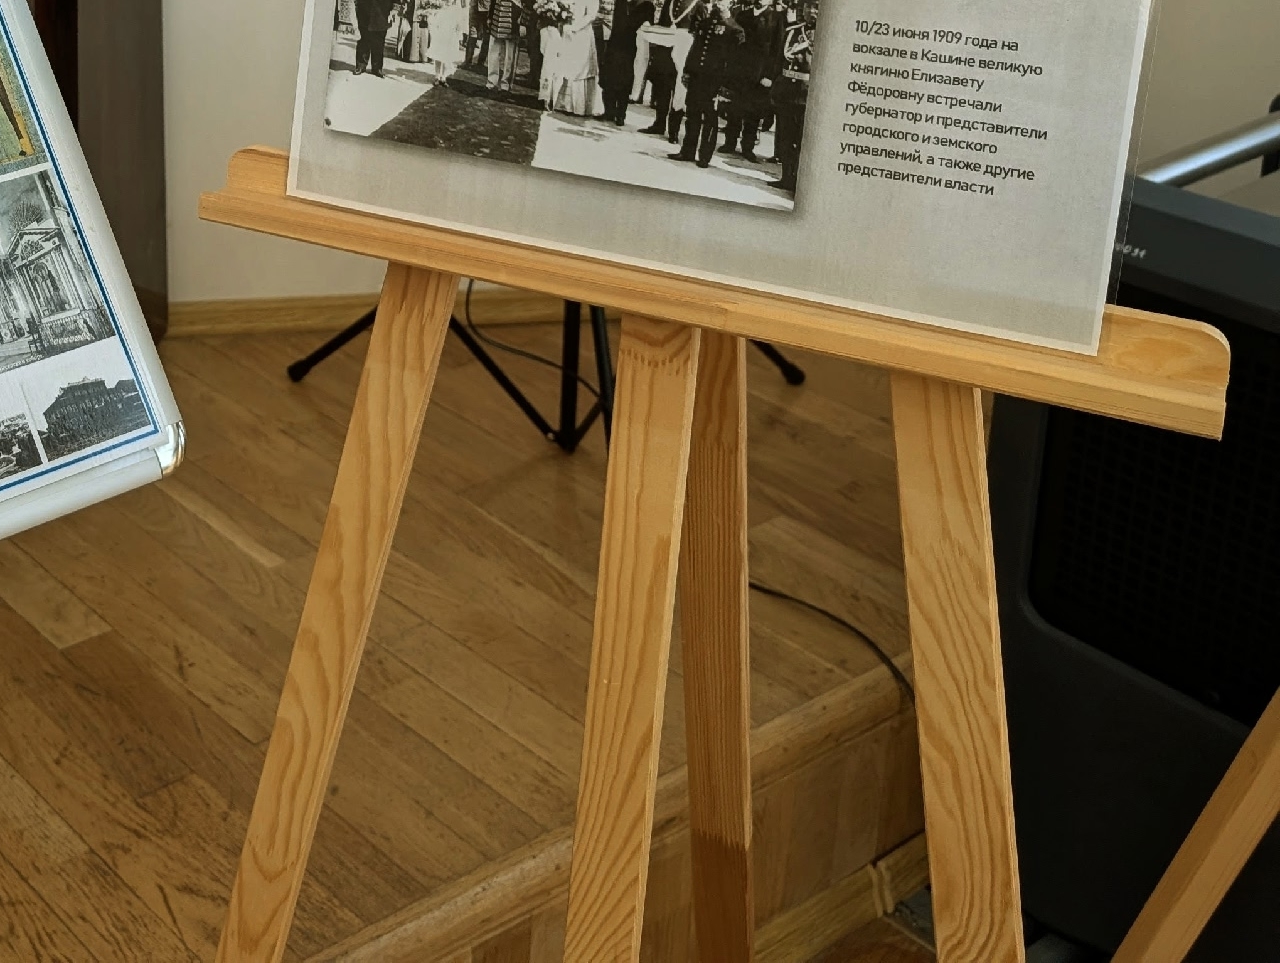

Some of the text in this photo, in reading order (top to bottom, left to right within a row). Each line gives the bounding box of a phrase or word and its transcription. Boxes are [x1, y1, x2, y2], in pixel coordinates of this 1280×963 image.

[856, 20, 1018, 51] 10/23 июня 1909 года на
[853, 43, 1042, 77] вокзале в Кашине великую
[850, 63, 984, 92] княгиню Елизавету
[848, 81, 1002, 112] Фёдоровну встречали
[845, 102, 1047, 140] губернатор и представители
[843, 123, 997, 154] городского и земского
[840, 142, 1035, 180] управлений, а также другие
[838, 163, 994, 195] представители власти
